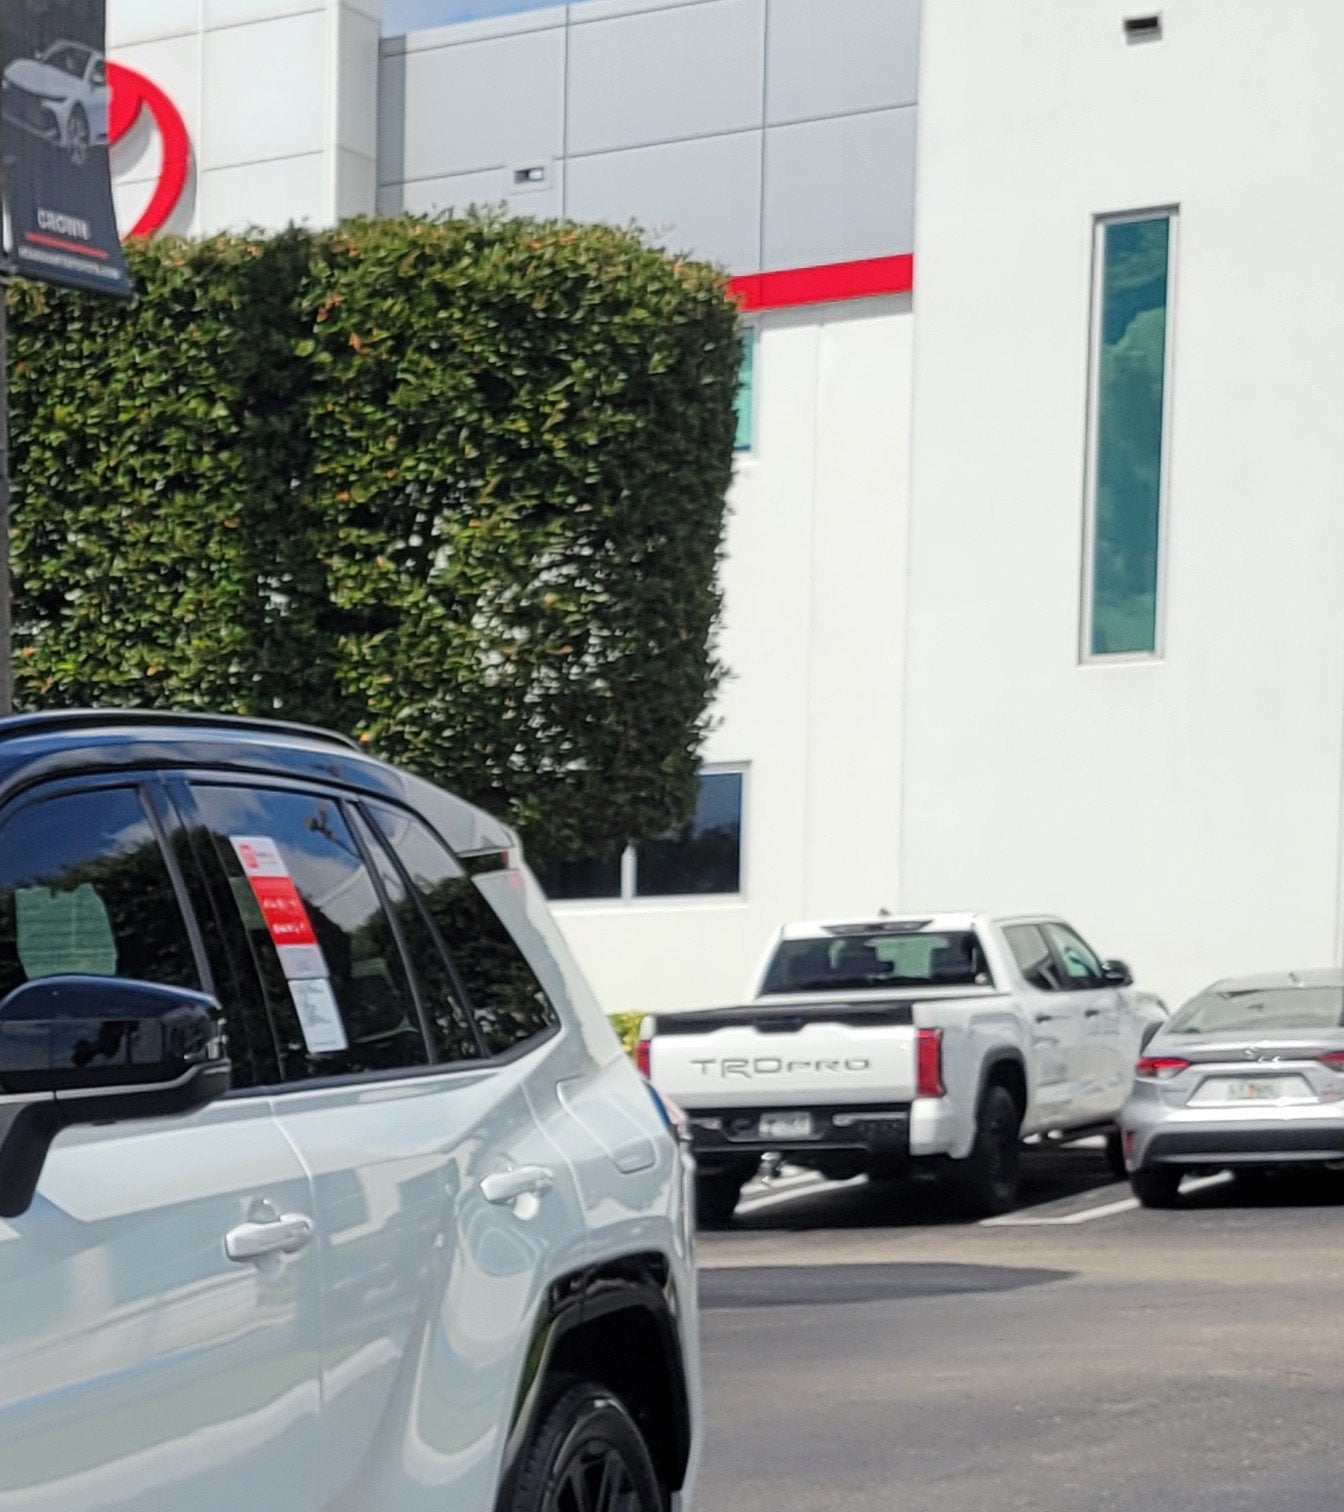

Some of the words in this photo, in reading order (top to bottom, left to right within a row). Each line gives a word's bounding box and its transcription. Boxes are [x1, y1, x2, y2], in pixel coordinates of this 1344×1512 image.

[37, 208, 91, 241] CROWN
[689, 1057, 782, 1079] TRD
[787, 1059, 870, 1073] PRO
